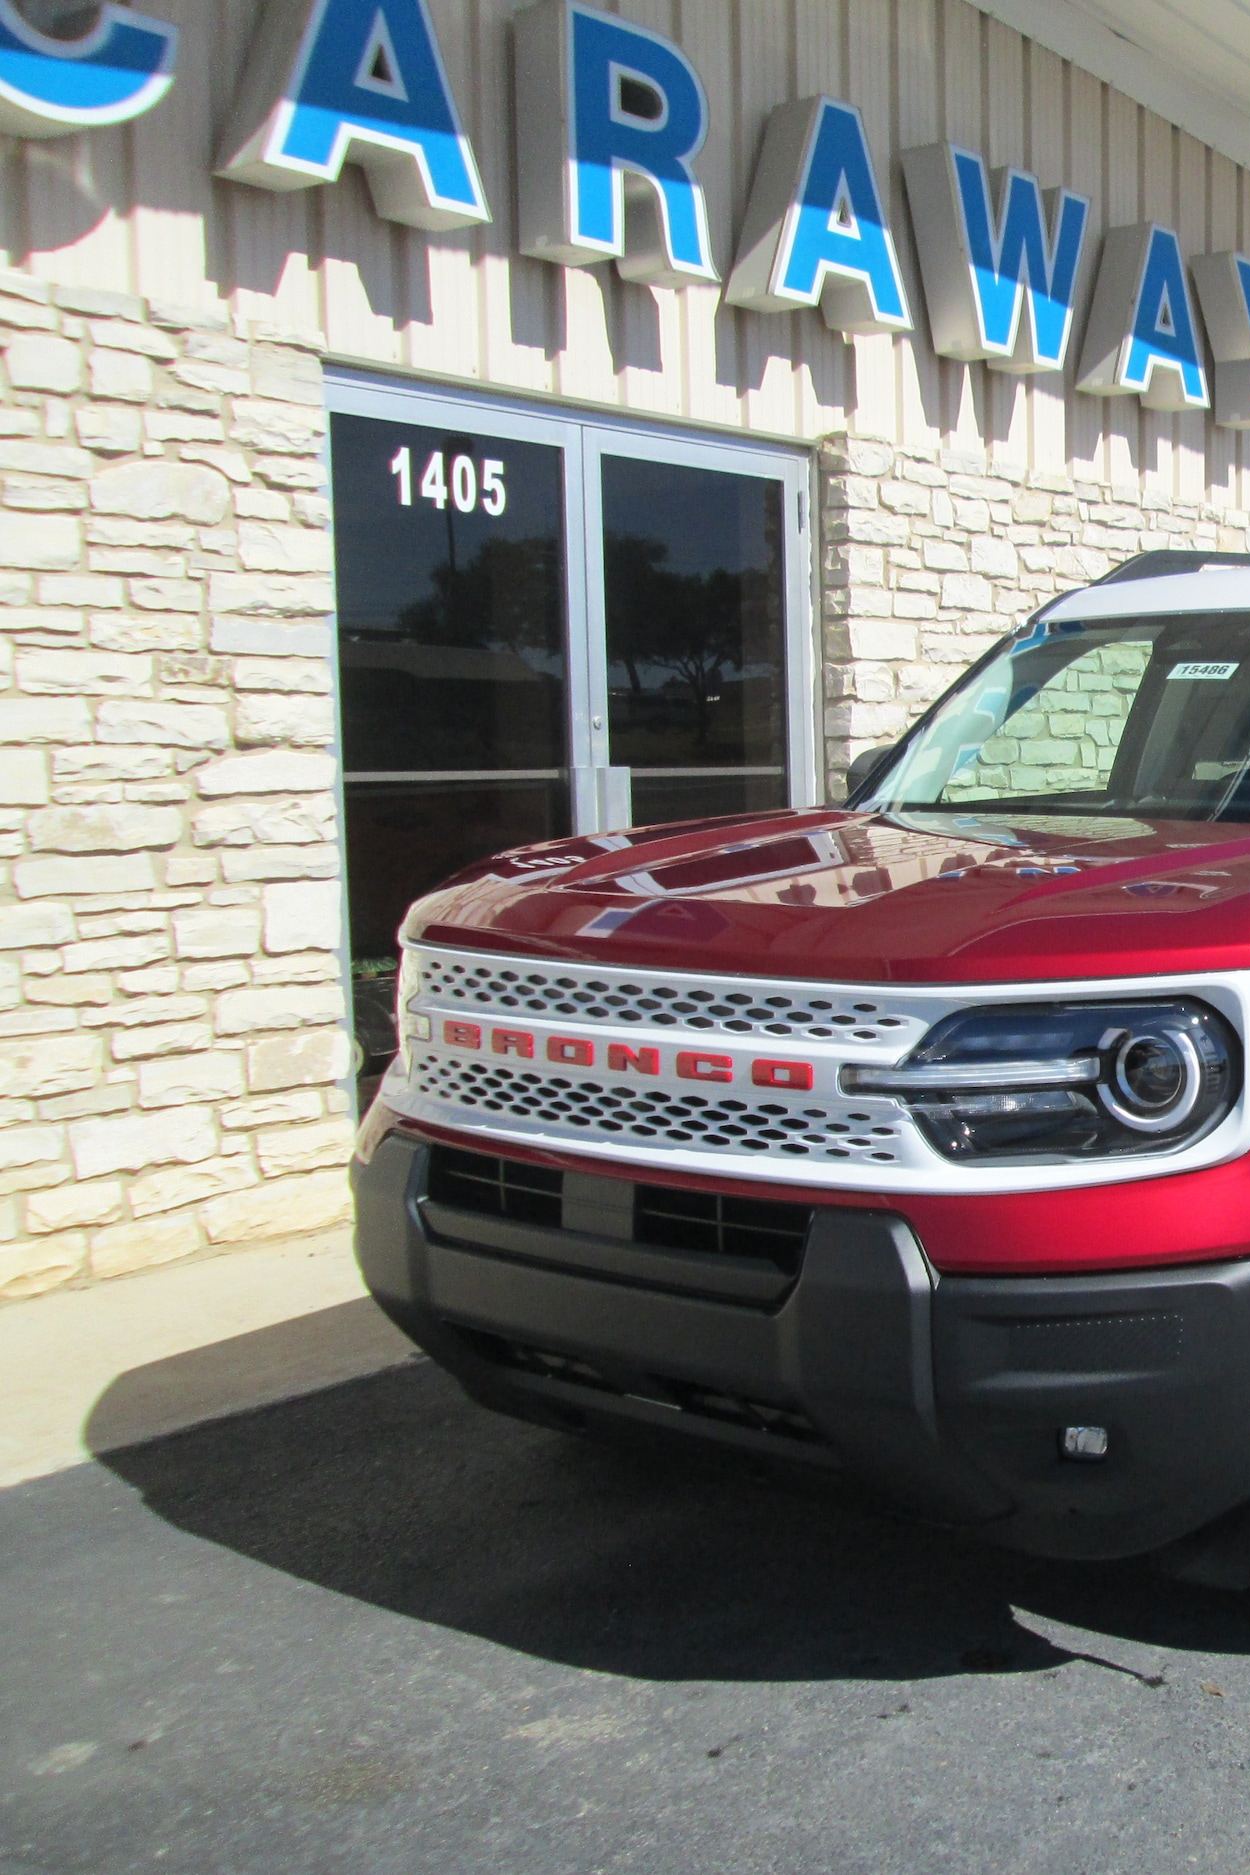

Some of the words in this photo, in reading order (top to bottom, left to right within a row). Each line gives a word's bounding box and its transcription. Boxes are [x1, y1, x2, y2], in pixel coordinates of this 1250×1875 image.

[389, 446, 507, 516] 1405
[1180, 665, 1230, 675] 15486
[444, 1020, 813, 1091] BRONCO
